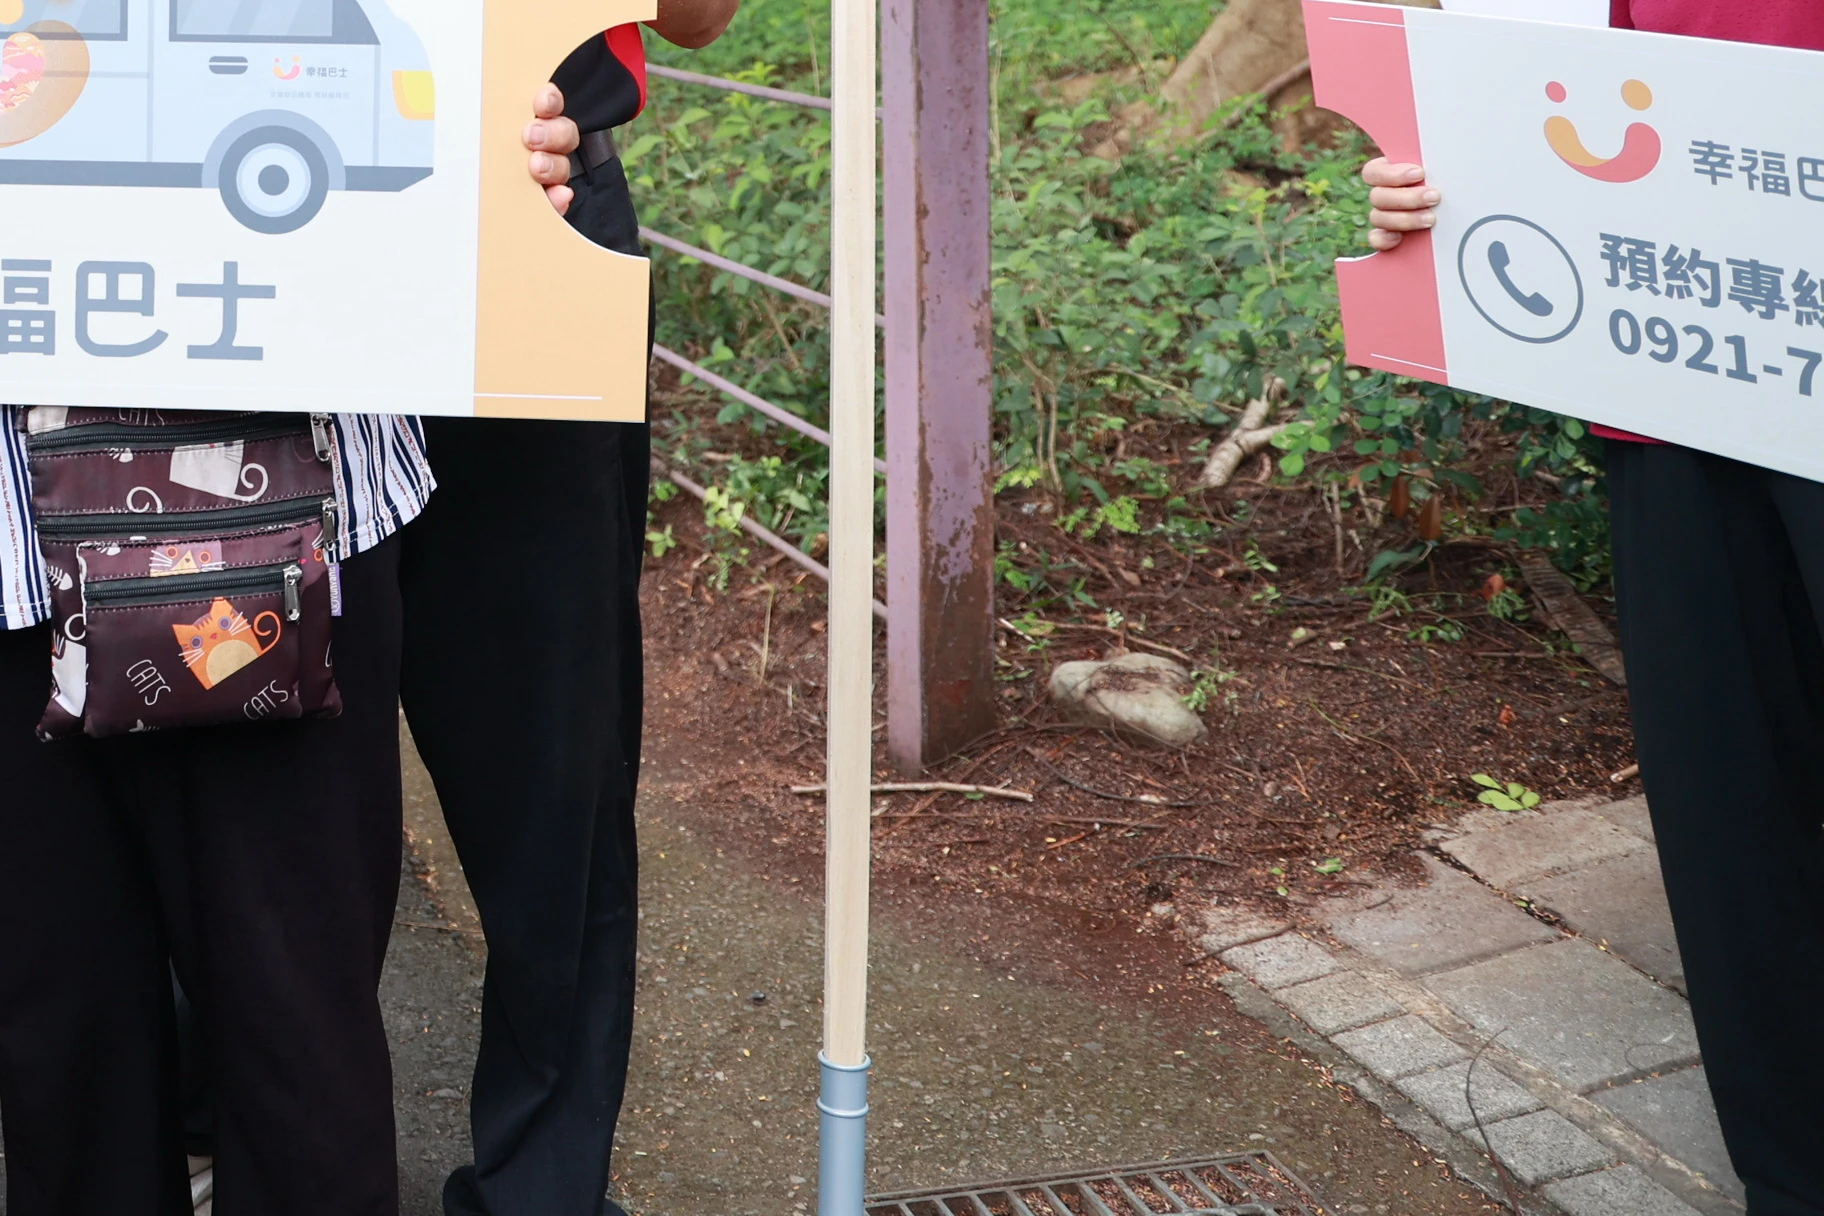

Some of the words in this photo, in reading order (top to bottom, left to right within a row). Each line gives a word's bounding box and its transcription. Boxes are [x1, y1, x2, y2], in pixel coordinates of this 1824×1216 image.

[305, 66, 349, 79] 幸福巴士
[1609, 307, 1823, 398] 0921-7
[126, 659, 172, 706] CATS
[243, 679, 289, 721] CATS
